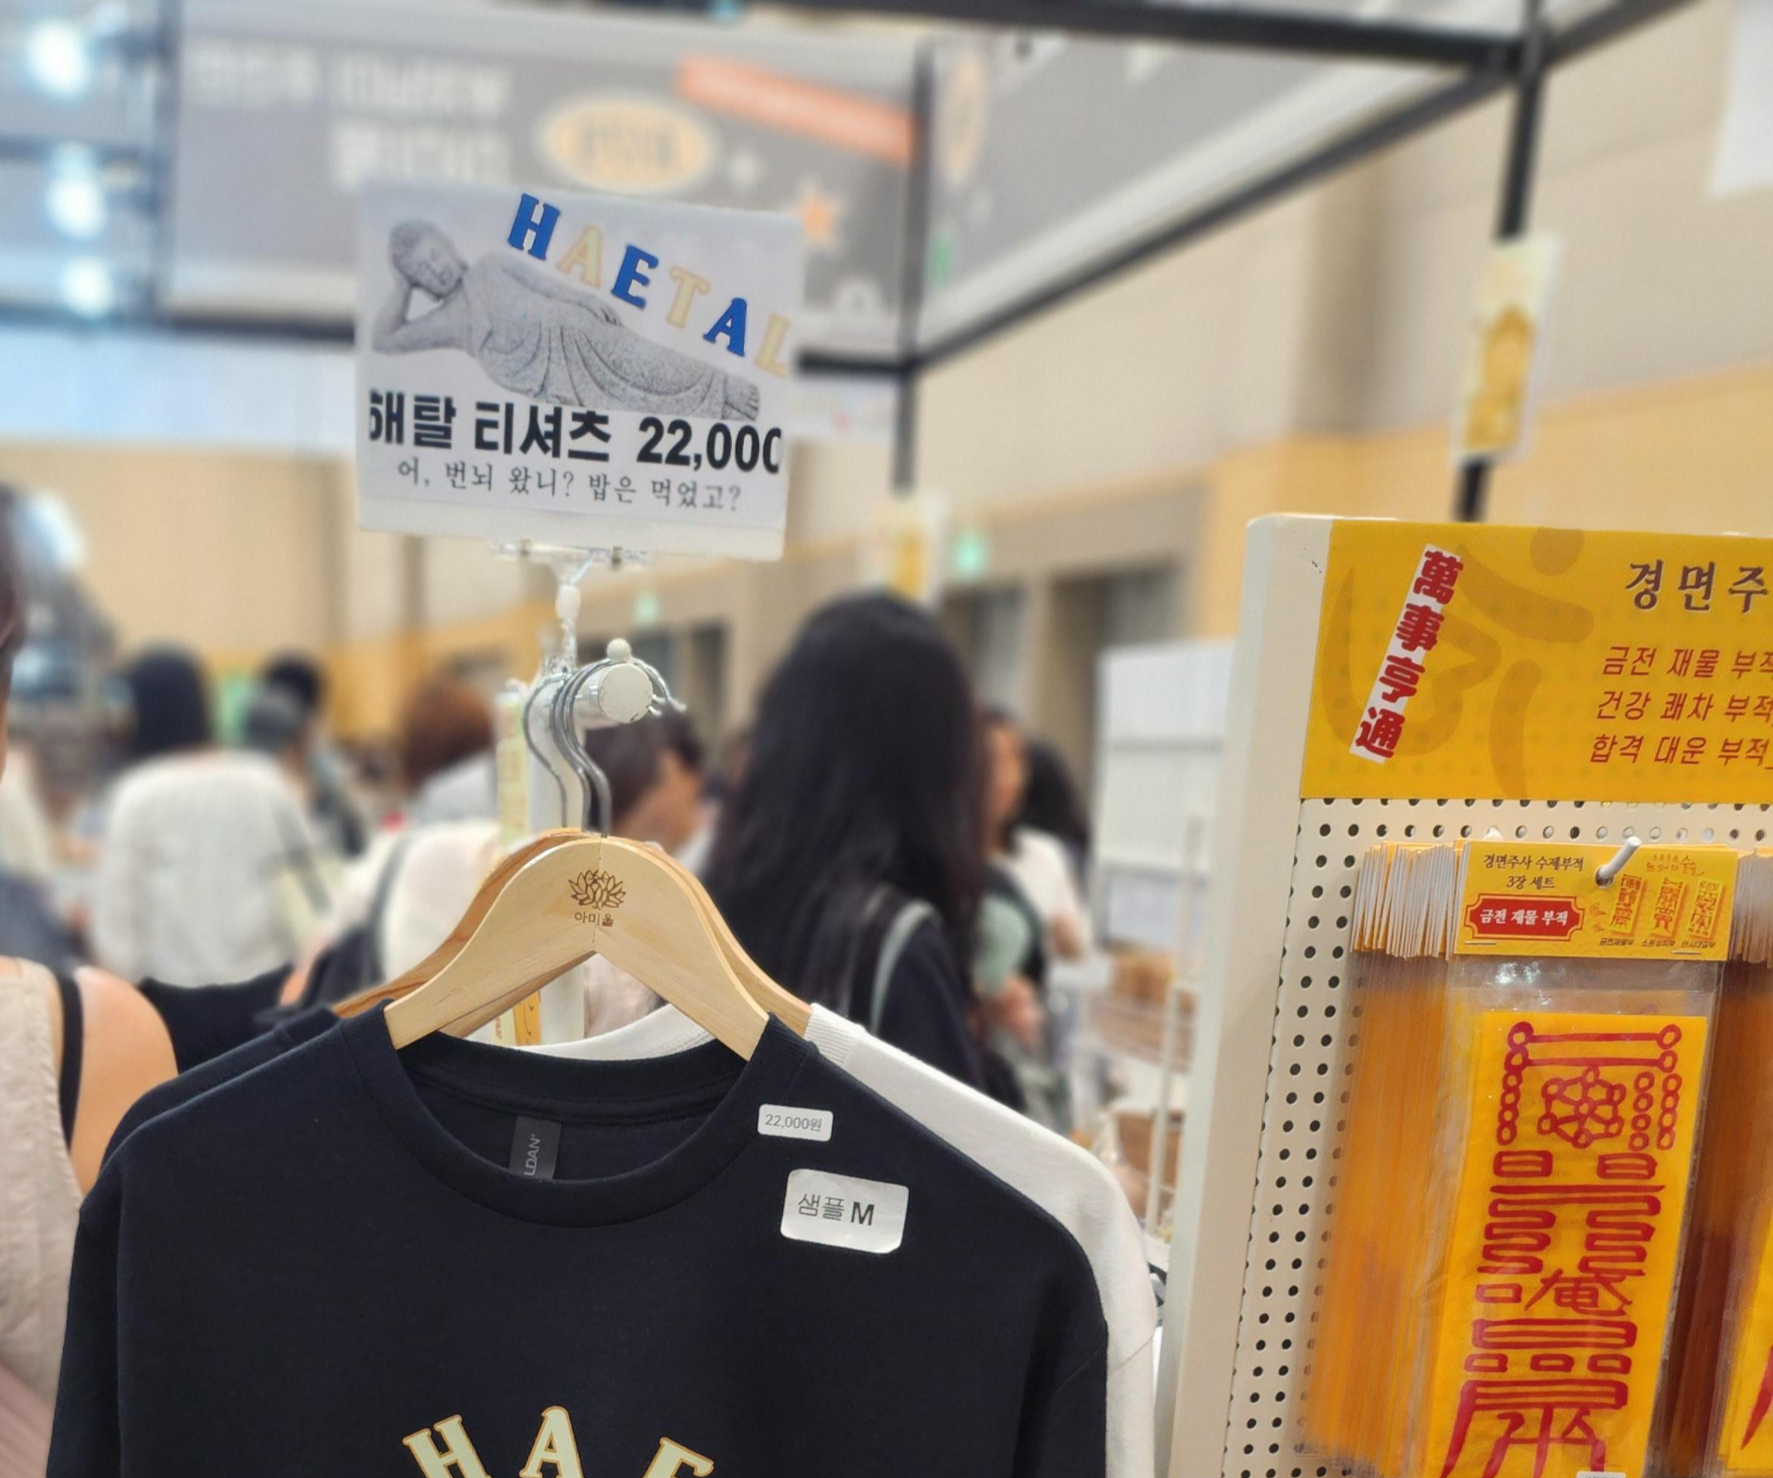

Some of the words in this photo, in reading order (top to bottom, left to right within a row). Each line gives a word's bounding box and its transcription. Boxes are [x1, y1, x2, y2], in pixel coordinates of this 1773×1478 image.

[507, 193, 789, 379] HAETAL
[368, 388, 457, 450] 해탈
[474, 401, 612, 462] 티셔츠
[398, 456, 430, 487] 어,
[446, 462, 493, 491] 번뇌
[508, 469, 575, 498] 왔니?
[588, 473, 638, 503] 밥은
[650, 479, 742, 512] 먹었고?
[1602, 646, 1657, 676] 금전
[1667, 648, 1720, 679] 재물
[1596, 691, 1651, 721] 건강
[1590, 734, 1644, 764] 합격
[1654, 736, 1707, 765] 대운
[1483, 853, 1533, 873] 경면주사
[1530, 876, 1556, 890] 세트
[1479, 908, 1507, 925] 금전
[1541, 910, 1570, 927] 부적
[765, 1114, 823, 1132] 22,000원
[798, 1193, 845, 1221] 샘플
[850, 1201, 875, 1226] M
